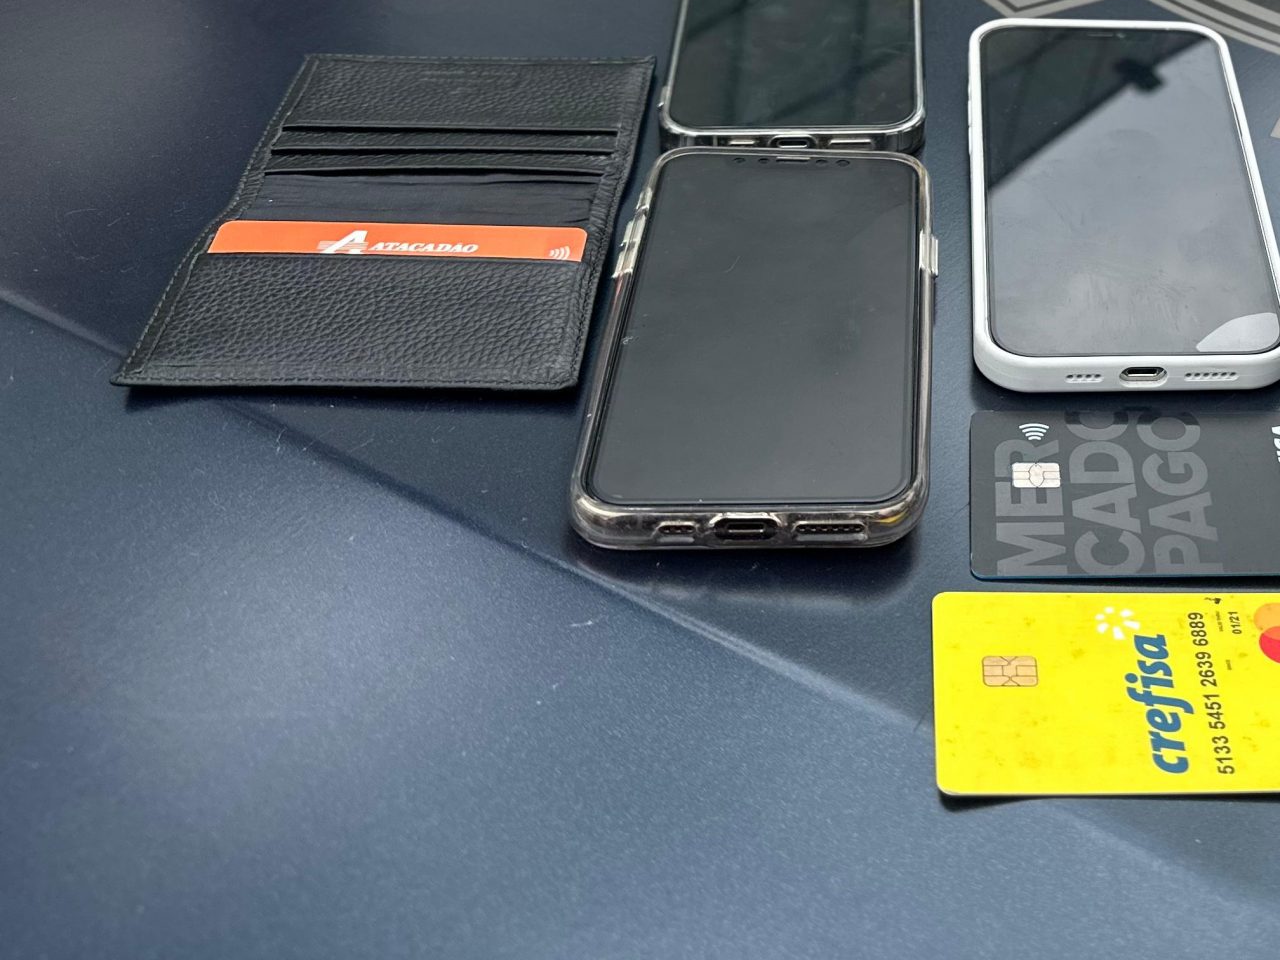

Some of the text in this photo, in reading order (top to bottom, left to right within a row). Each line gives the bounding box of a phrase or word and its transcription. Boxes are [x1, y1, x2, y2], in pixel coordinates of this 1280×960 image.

[994, 439, 1068, 576] MER
[1136, 411, 1224, 576] PAGO
[1228, 611, 1243, 635] 01/21
[1124, 634, 1195, 773] crefisa
[1188, 612, 1235, 775] 5133 5451 2639 6889
